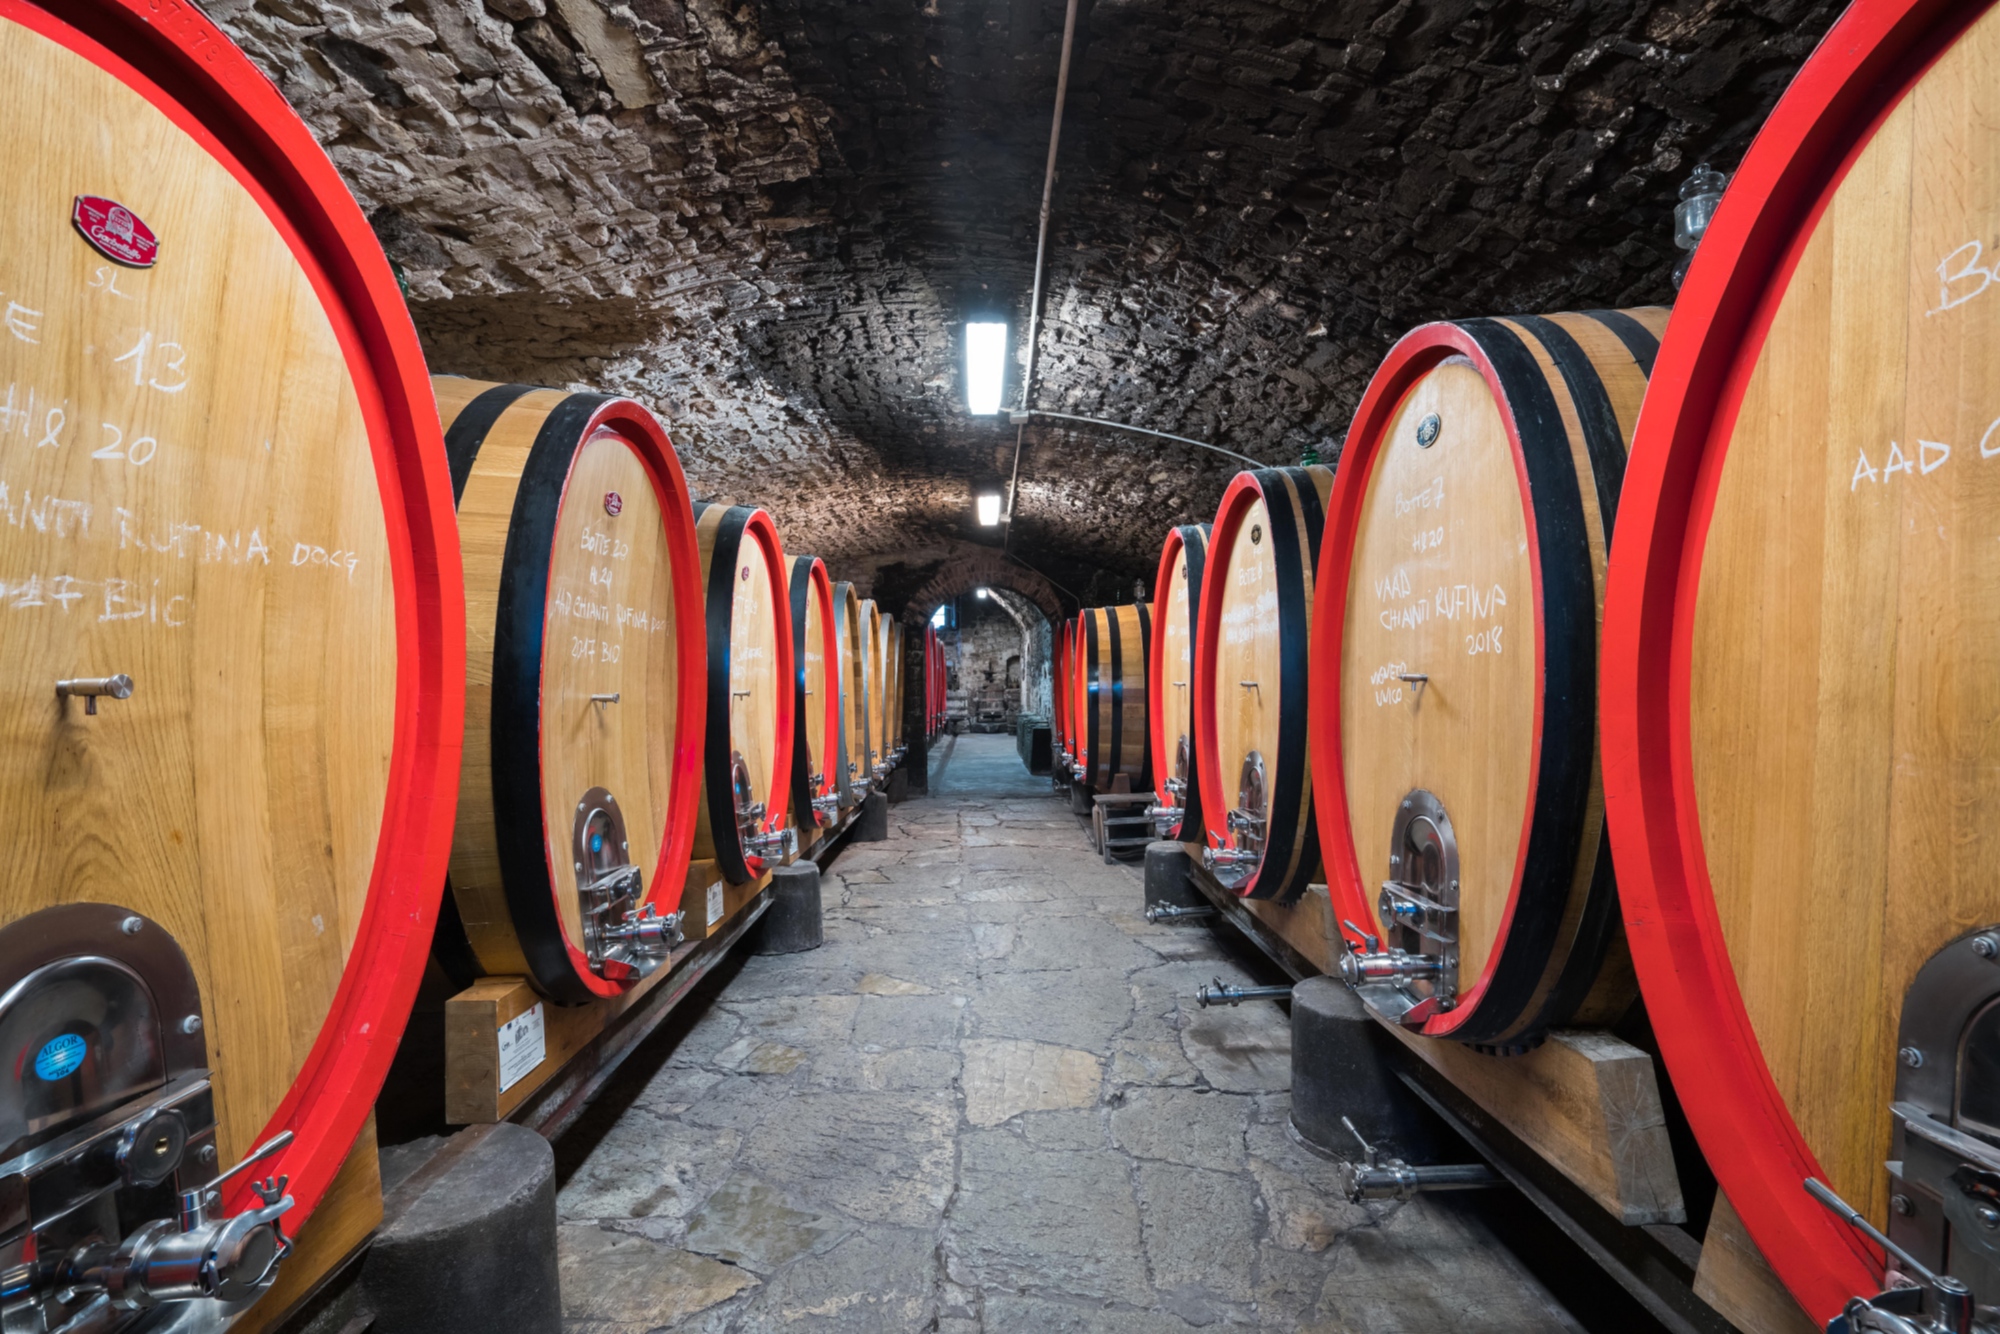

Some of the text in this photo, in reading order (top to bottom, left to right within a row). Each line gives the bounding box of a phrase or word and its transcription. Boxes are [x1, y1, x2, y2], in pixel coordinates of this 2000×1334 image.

[1924, 239, 2000, 317] B
[113, 332, 188, 393] 13
[91, 422, 157, 465] 20
[1850, 439, 1951, 492] AAD
[1466, 625, 1503, 656] 2018
[41, 1035, 78, 1058] ALGOR
